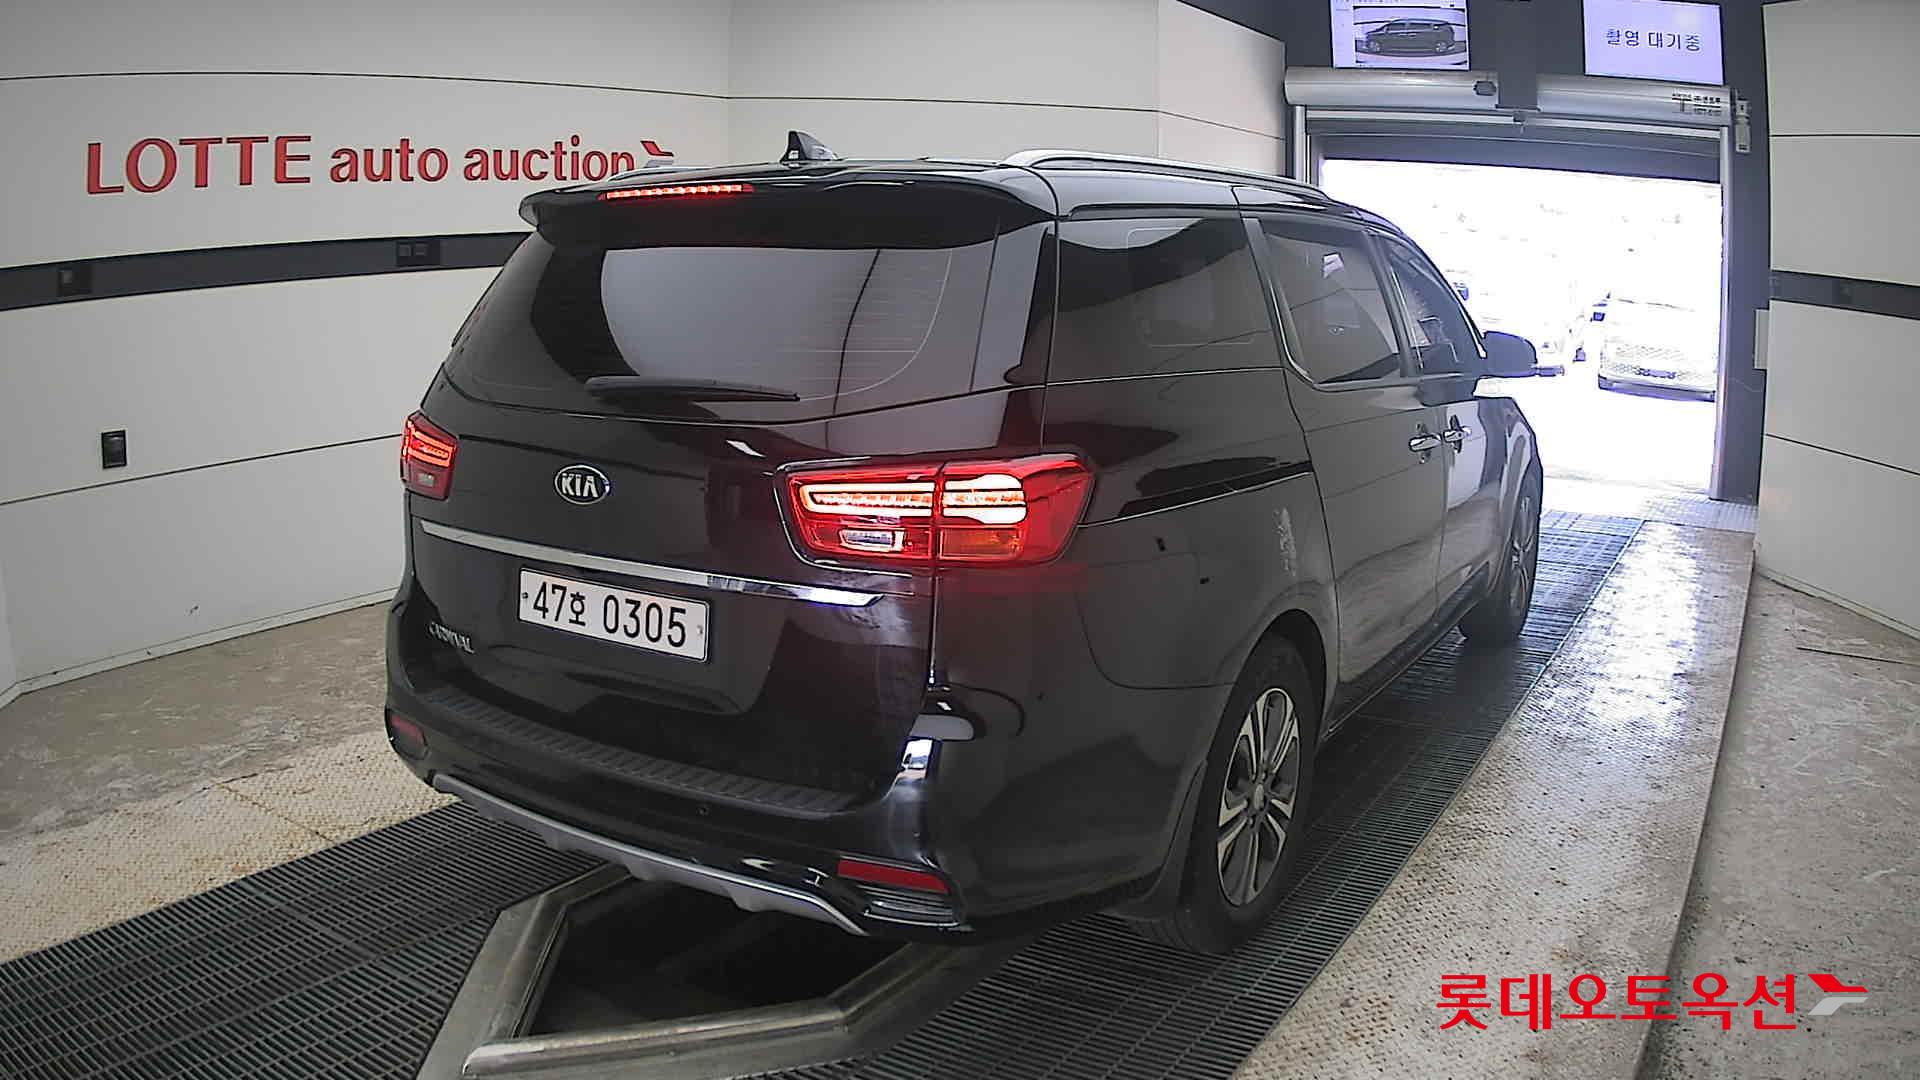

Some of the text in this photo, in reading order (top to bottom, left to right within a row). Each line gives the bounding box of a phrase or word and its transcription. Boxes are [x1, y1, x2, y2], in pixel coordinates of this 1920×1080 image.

[1648, 32, 1701, 51] 대기중
[87, 135, 634, 194] LOTTE auto auction
[561, 473, 598, 498] KIA
[533, 581, 686, 647] 47호 0305
